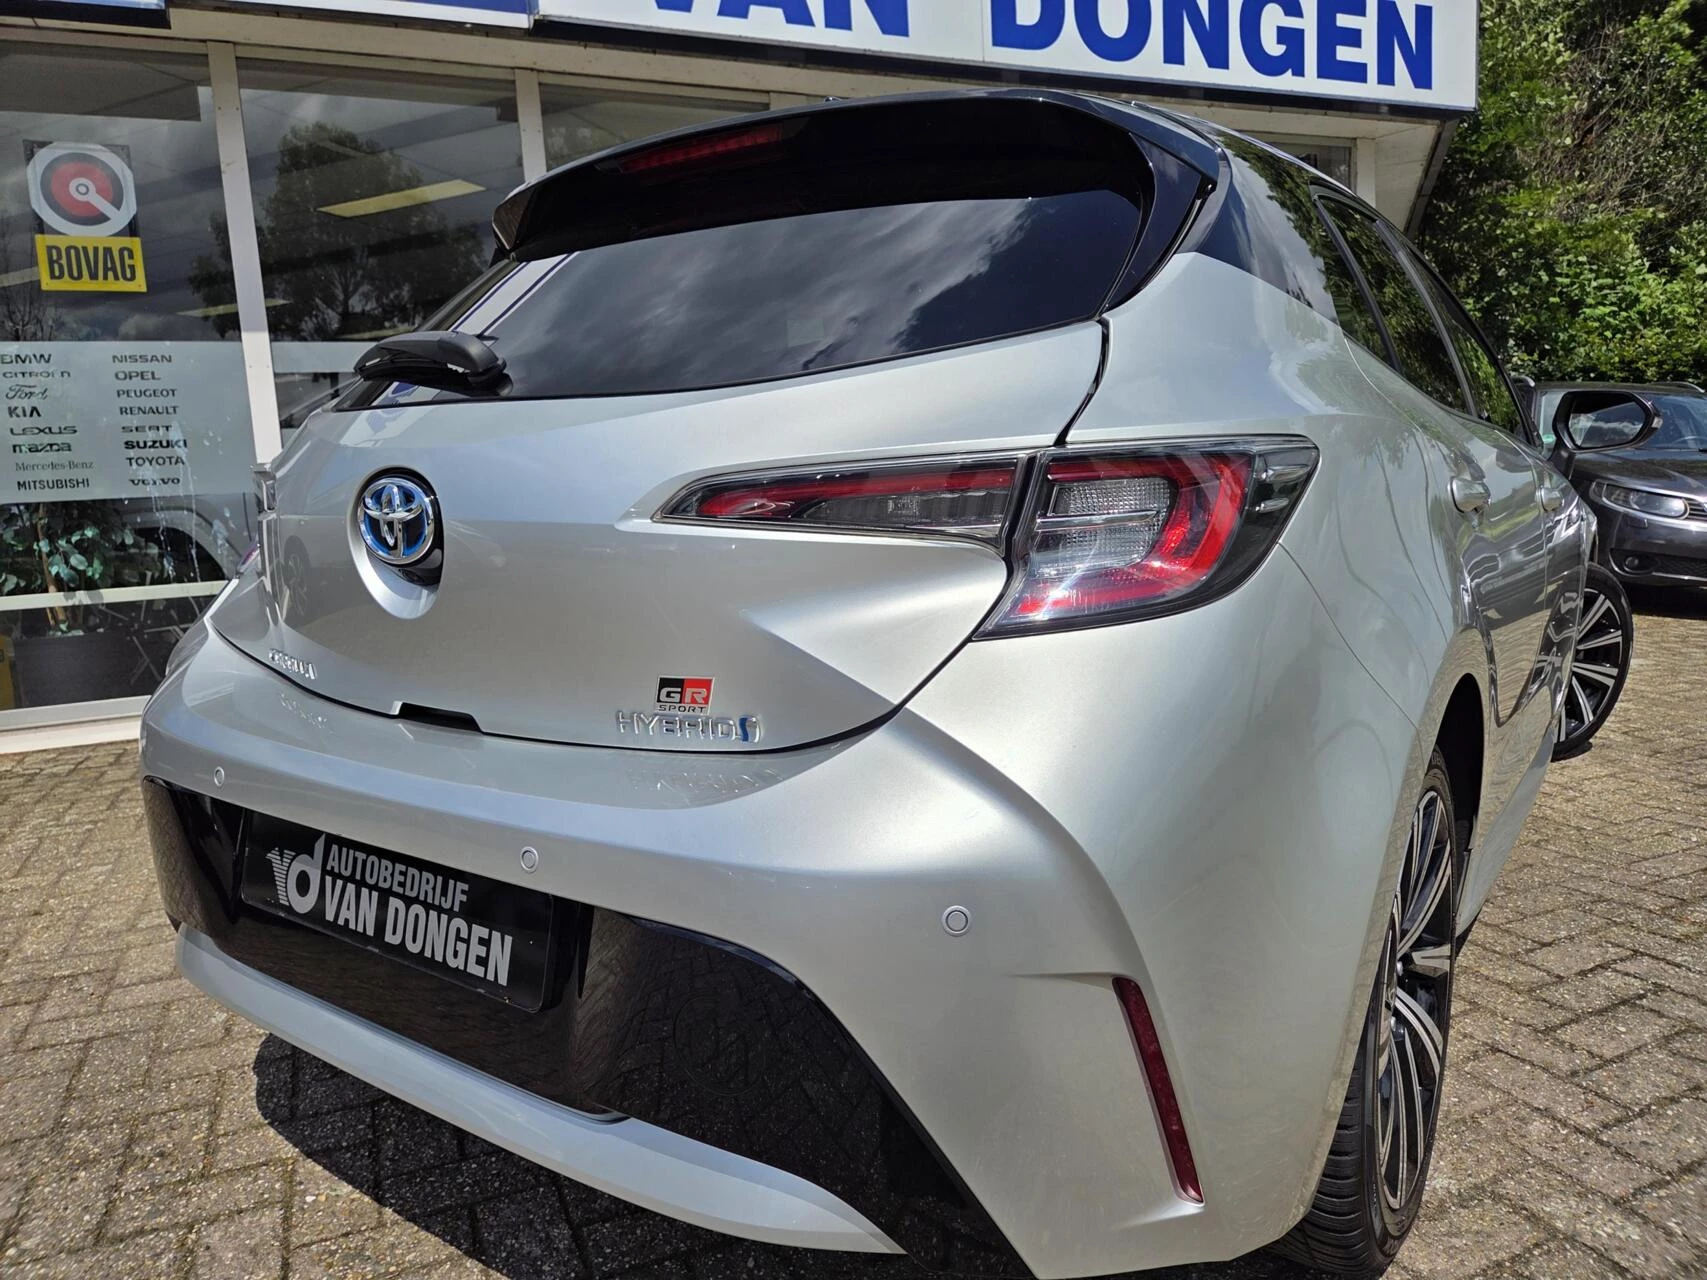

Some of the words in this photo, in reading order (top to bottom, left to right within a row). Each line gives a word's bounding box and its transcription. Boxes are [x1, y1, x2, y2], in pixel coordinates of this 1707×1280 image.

[990, 0, 1433, 90] DONGEN
[46, 244, 136, 282] BOVAG
[0, 353, 52, 364] BMW
[112, 354, 172, 363] NISSAN
[115, 370, 162, 381] OPEL
[6, 384, 48, 400] Ford
[116, 388, 177, 398] PEUGEOT
[8, 406, 42, 418] KIA
[119, 406, 179, 416] RENAULT
[9, 426, 78, 436] LEXUS
[121, 425, 172, 433] SEAT
[124, 439, 188, 450] SUZUKI
[15, 460, 94, 472] Mercedes-Benz
[125, 456, 185, 467] TOYOTA
[17, 478, 90, 491] MITSUBISHI
[660, 687, 708, 704] GR
[658, 704, 707, 713] SPORT
[325, 843, 470, 913] AUTOBEDRIJF
[325, 875, 379, 937] VAN
[384, 896, 513, 986] DONGEN
